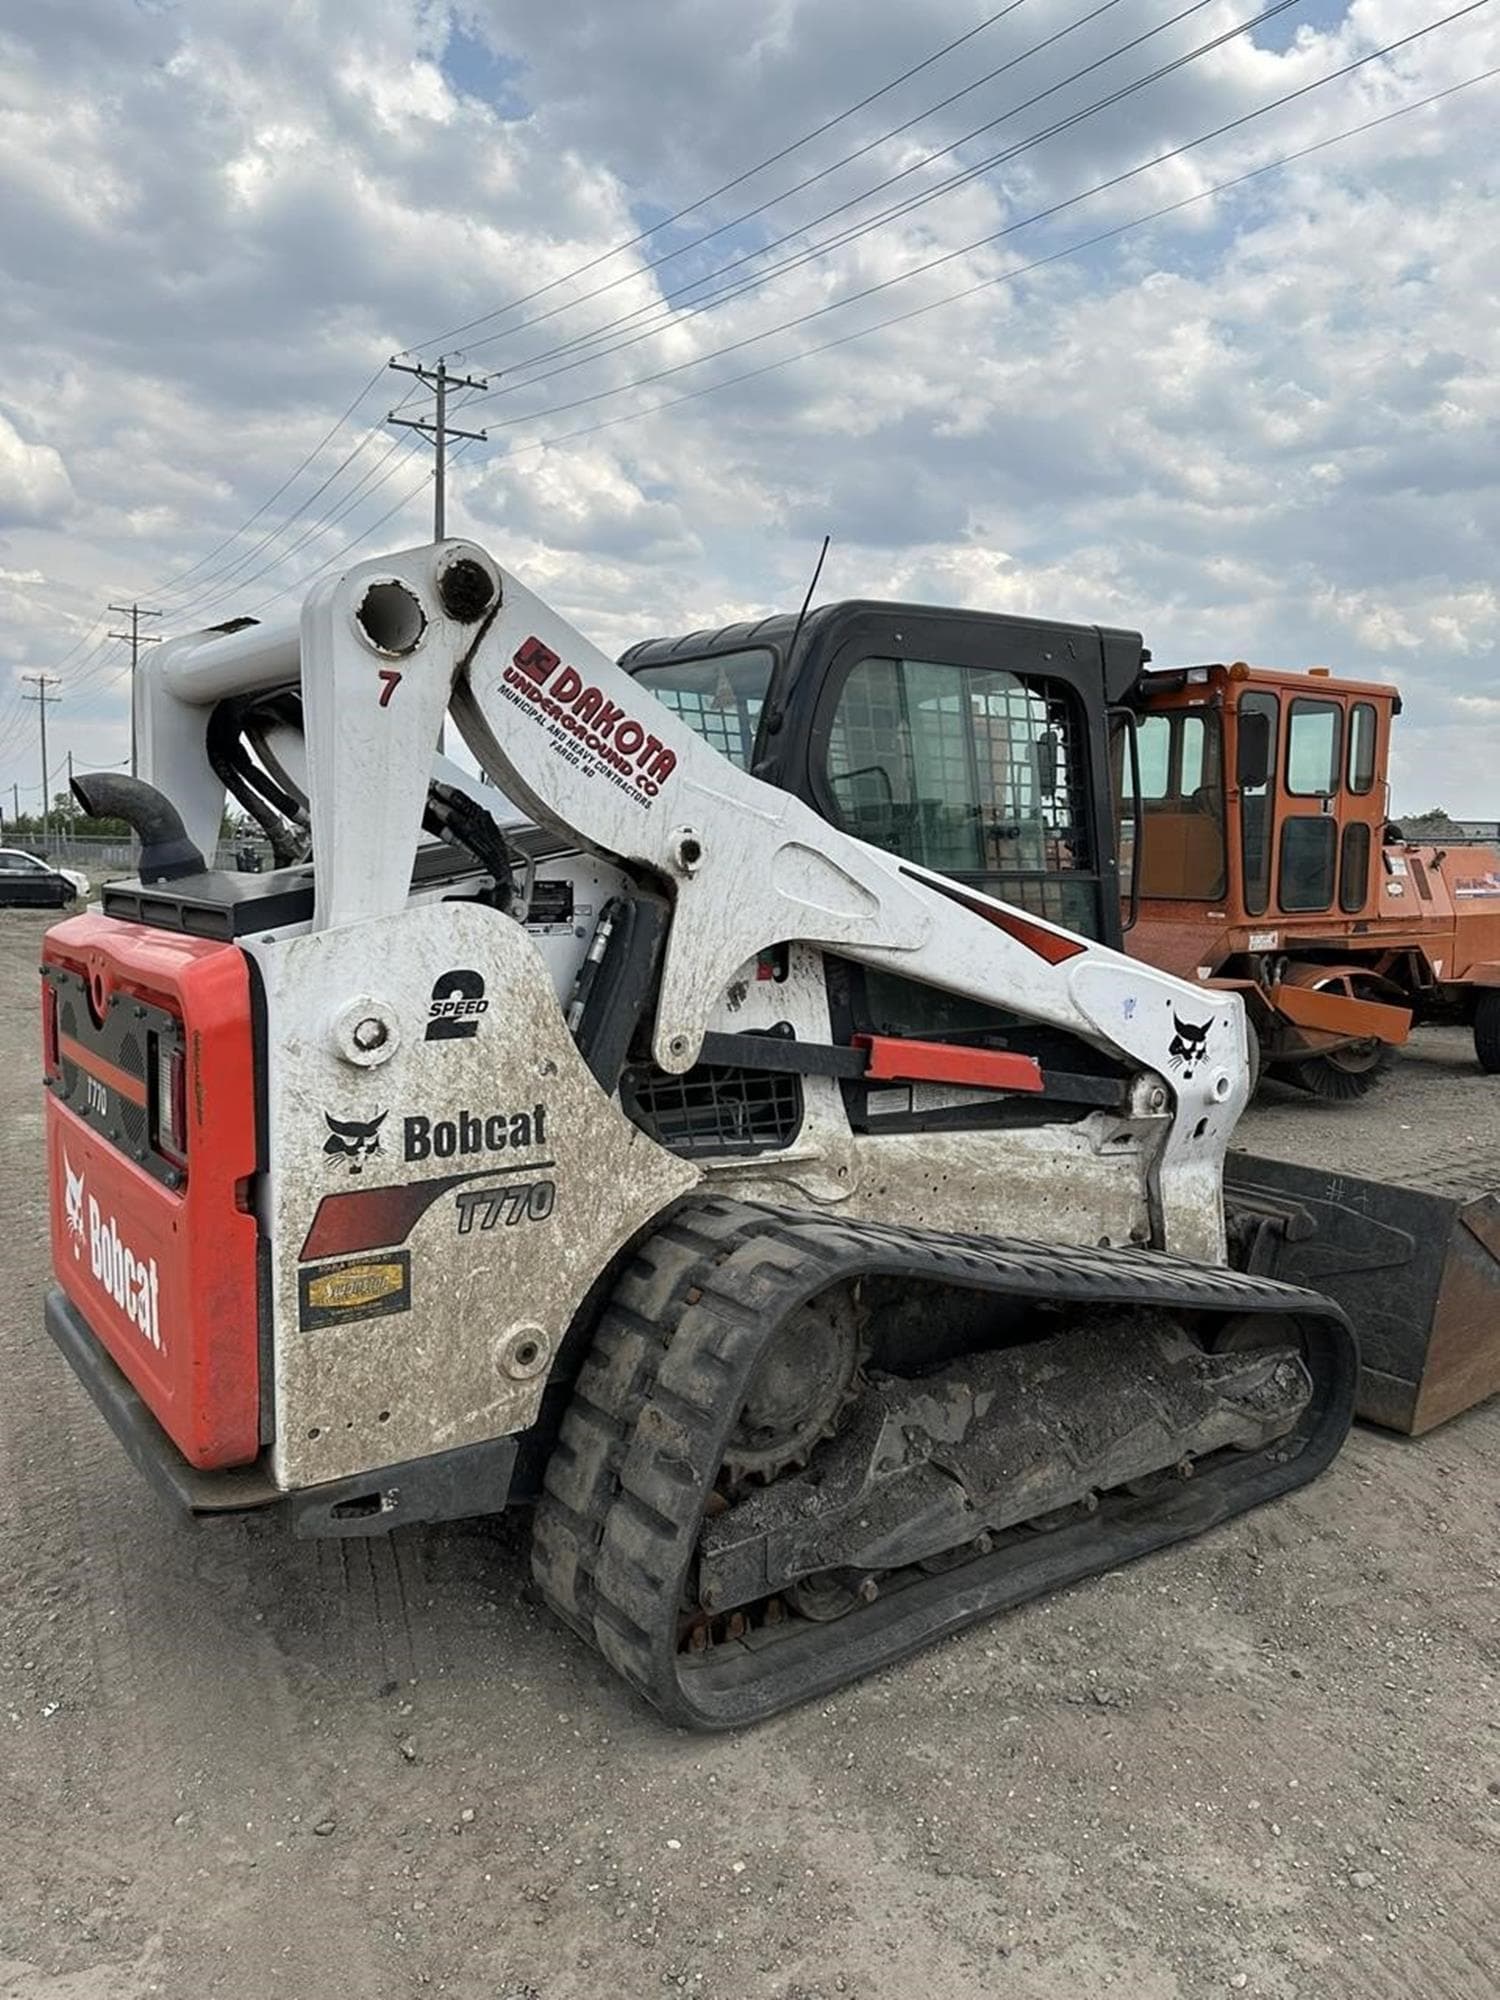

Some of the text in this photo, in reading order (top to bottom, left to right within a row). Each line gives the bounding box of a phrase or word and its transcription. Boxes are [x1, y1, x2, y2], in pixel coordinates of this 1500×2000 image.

[379, 669, 402, 707] 7
[497, 684, 653, 810] MUNICIPAL AND HEAVY CONTRACTORS
[502, 666, 659, 797] UNDERGROUND CO
[549, 665, 677, 785] DAKOTA
[581, 764, 596, 778] ND
[424, 969, 485, 1042] 2
[428, 1000, 489, 1017] SPEED
[404, 1104, 546, 1163] Bobcat
[456, 1180, 556, 1234] T770
[88, 1193, 160, 1350] Bobcat
